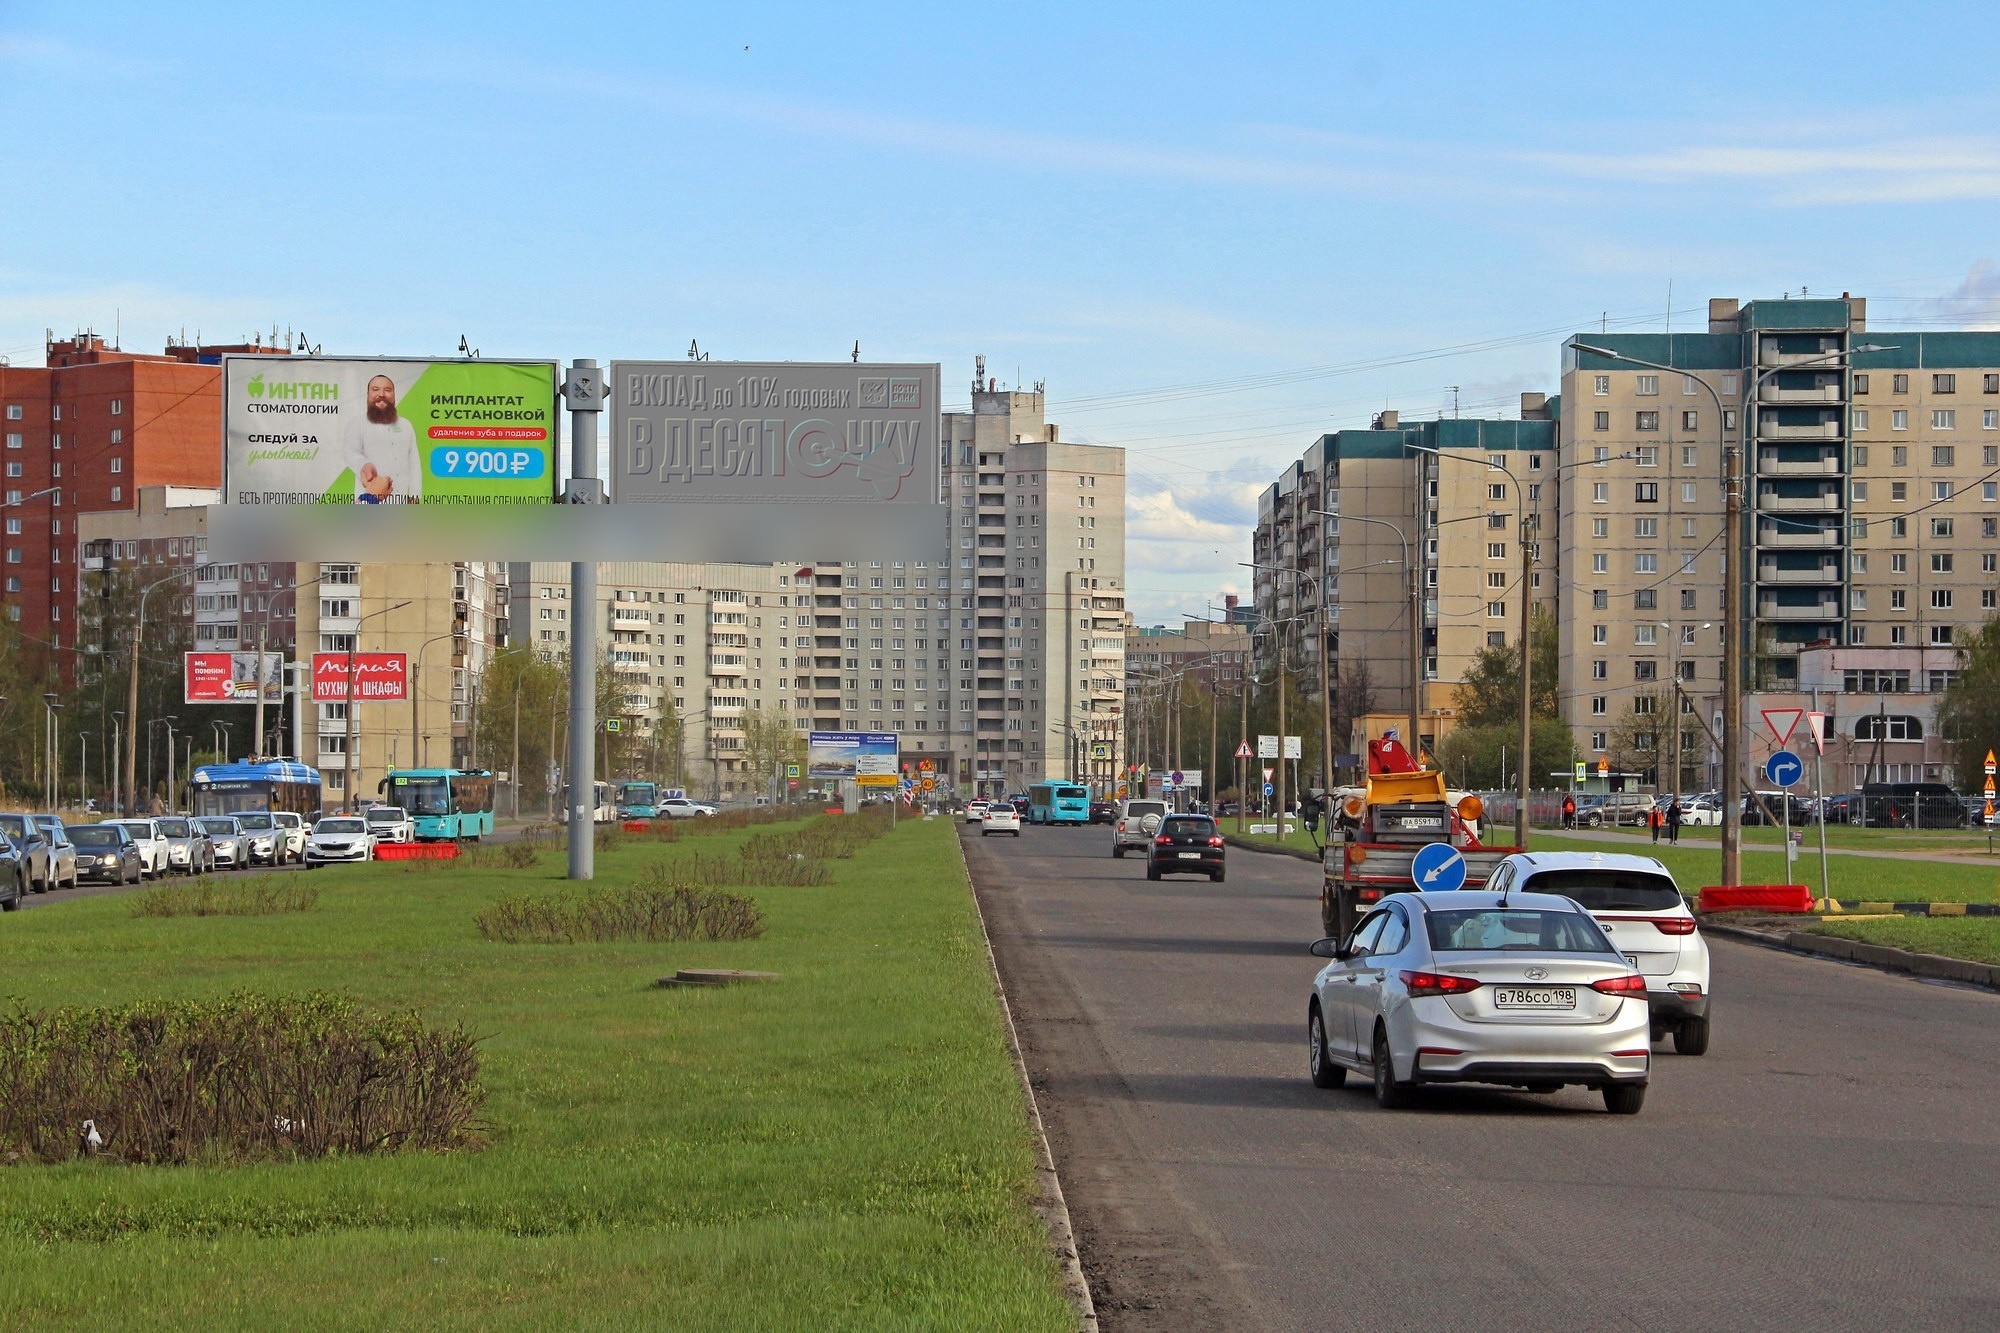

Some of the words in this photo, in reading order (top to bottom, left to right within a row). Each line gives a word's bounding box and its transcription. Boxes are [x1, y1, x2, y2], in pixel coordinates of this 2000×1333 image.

[269, 382, 338, 400] ИНТАН
[628, 374, 709, 411] ВКЛАД
[737, 376, 780, 408] 10%
[430, 394, 524, 406] ИМПЛАНТАТ
[247, 403, 338, 414] СТОМАТОЛОГИИ
[430, 409, 440, 419] С
[444, 408, 545, 421] УСТАНОВКОЙ
[248, 433, 298, 444] СЛЕДУЙ
[302, 435, 318, 443] ЗА
[433, 429, 475, 437] удаление
[477, 429, 496, 438] зуба
[628, 417, 653, 476] В
[247, 445, 320, 466] улыбкой!
[239, 491, 260, 504] ЕСТЬ
[222, 679, 236, 697] 9
[362, 681, 402, 696] ШКАФЫ
